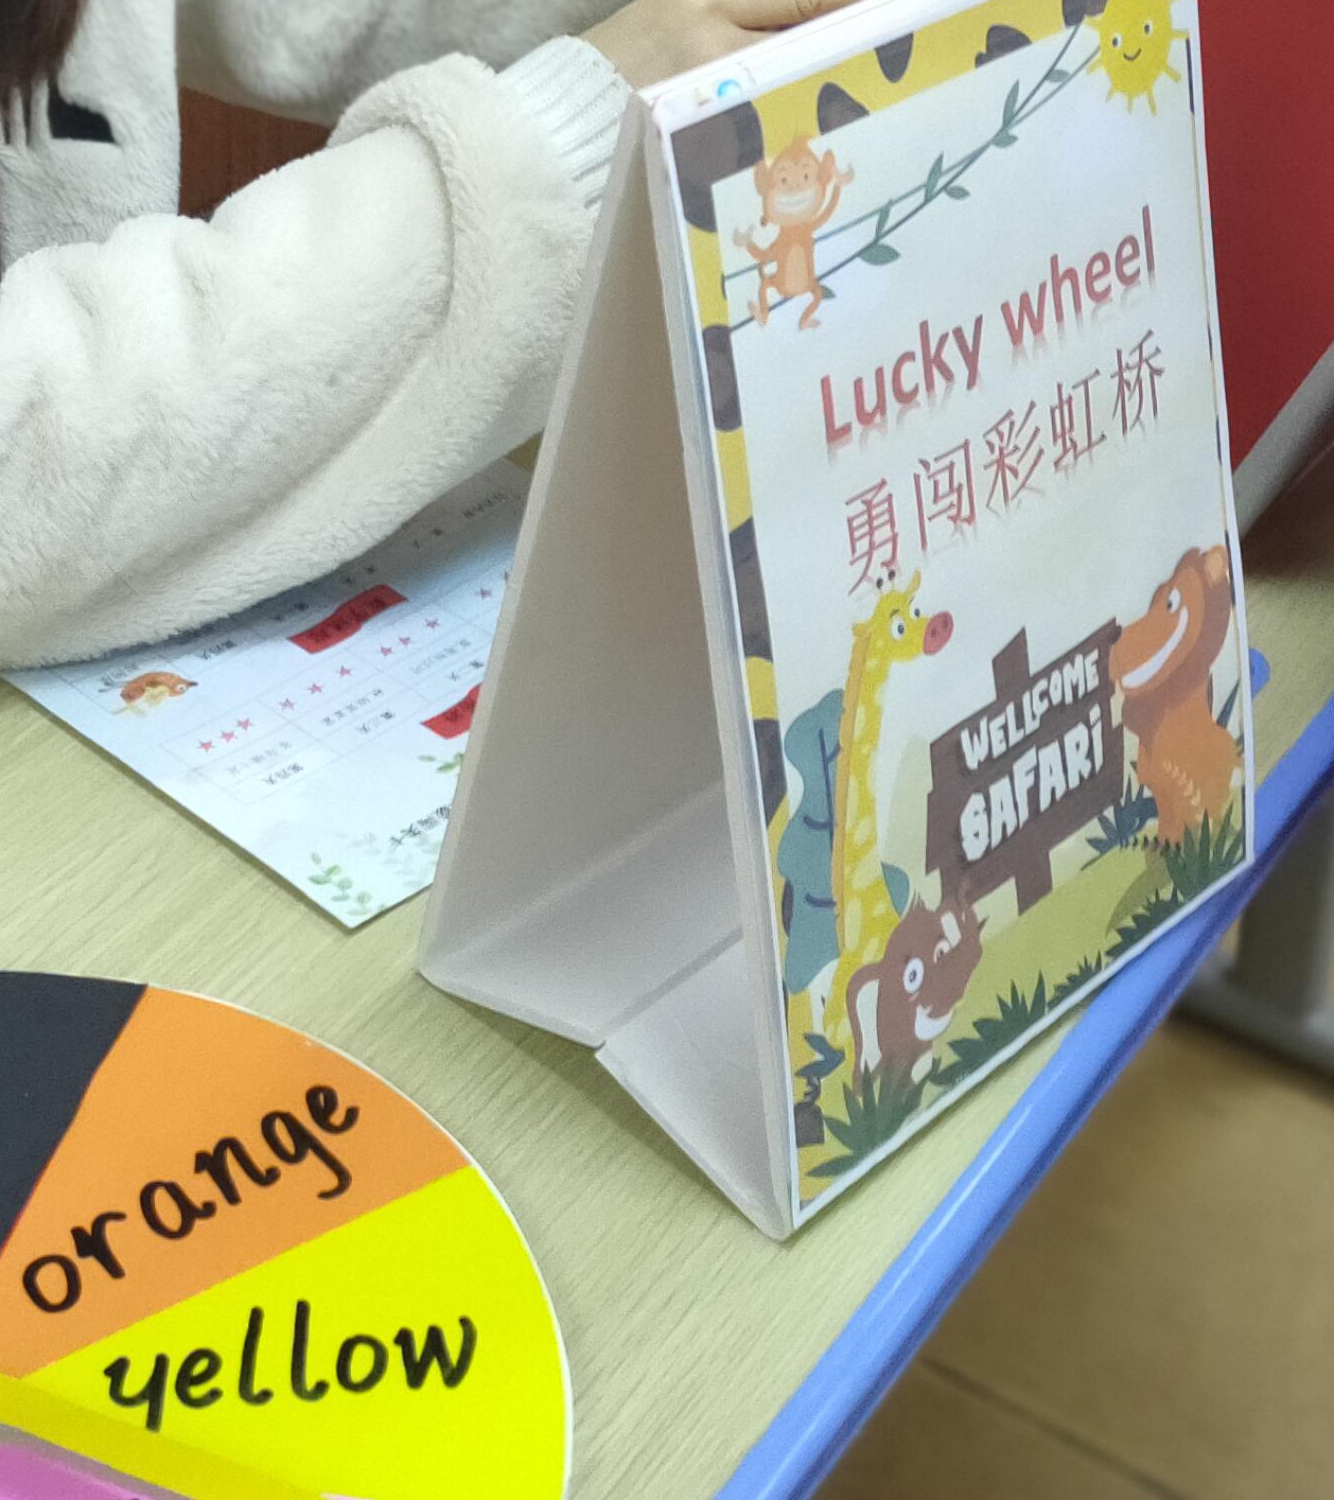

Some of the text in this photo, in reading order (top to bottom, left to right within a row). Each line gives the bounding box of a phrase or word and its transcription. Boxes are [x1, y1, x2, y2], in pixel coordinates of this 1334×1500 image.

[820, 204, 1156, 445] Lucky wheel
[845, 329, 1165, 596] 勇闯彩虹桥
[22, 1084, 359, 1313] orange
[103, 1299, 478, 1432] yellow
